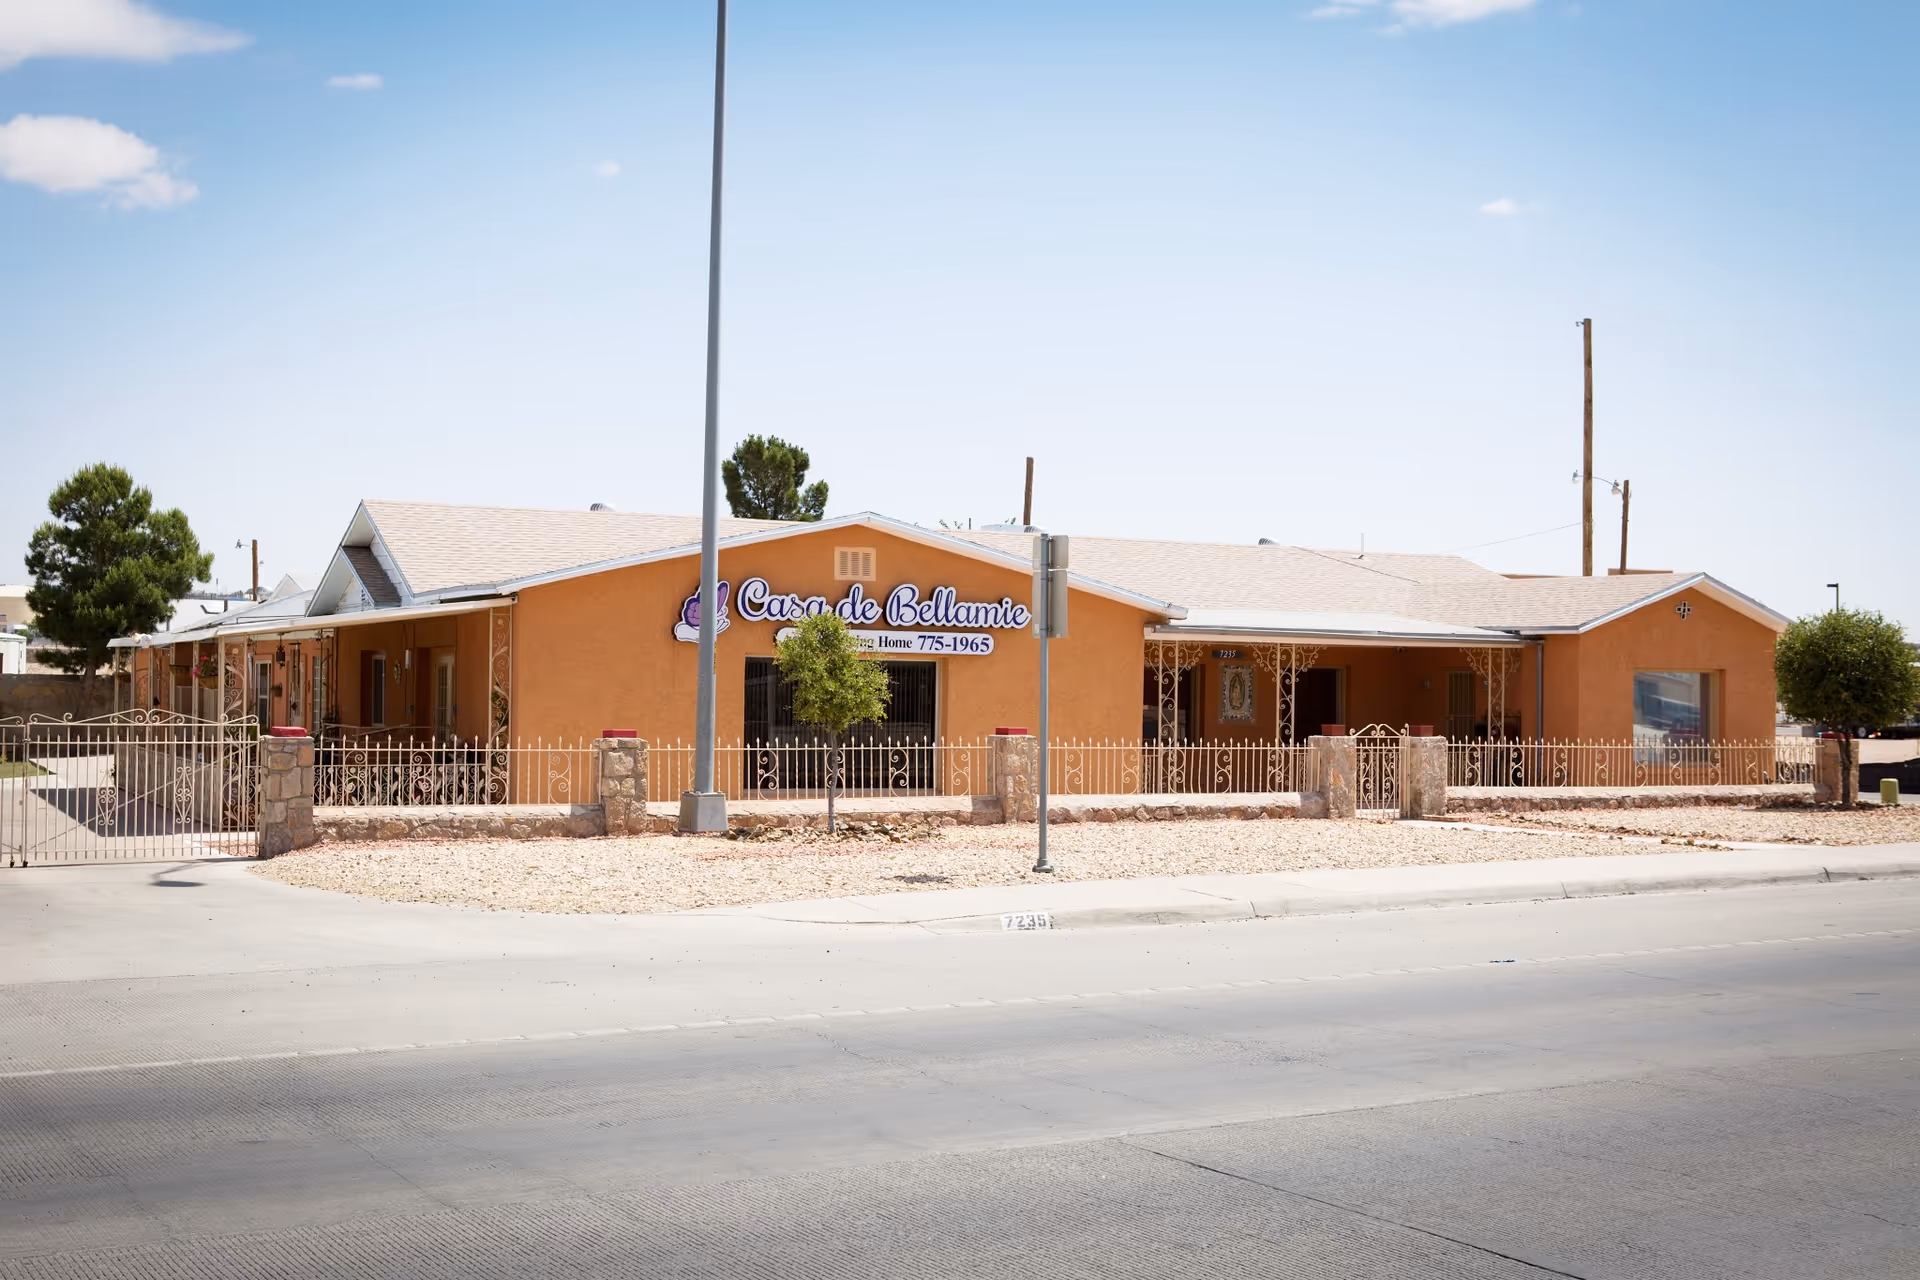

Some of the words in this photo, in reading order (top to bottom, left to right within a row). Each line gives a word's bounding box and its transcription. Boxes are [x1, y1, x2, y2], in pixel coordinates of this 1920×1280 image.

[740, 579, 828, 619] Casa
[839, 585, 881, 621] de
[888, 586, 1029, 626] Bellamie
[878, 635, 913, 649] Home
[917, 635, 990, 653] 775-1965
[1219, 649, 1237, 659] 7235
[1004, 914, 1047, 929] 7235
